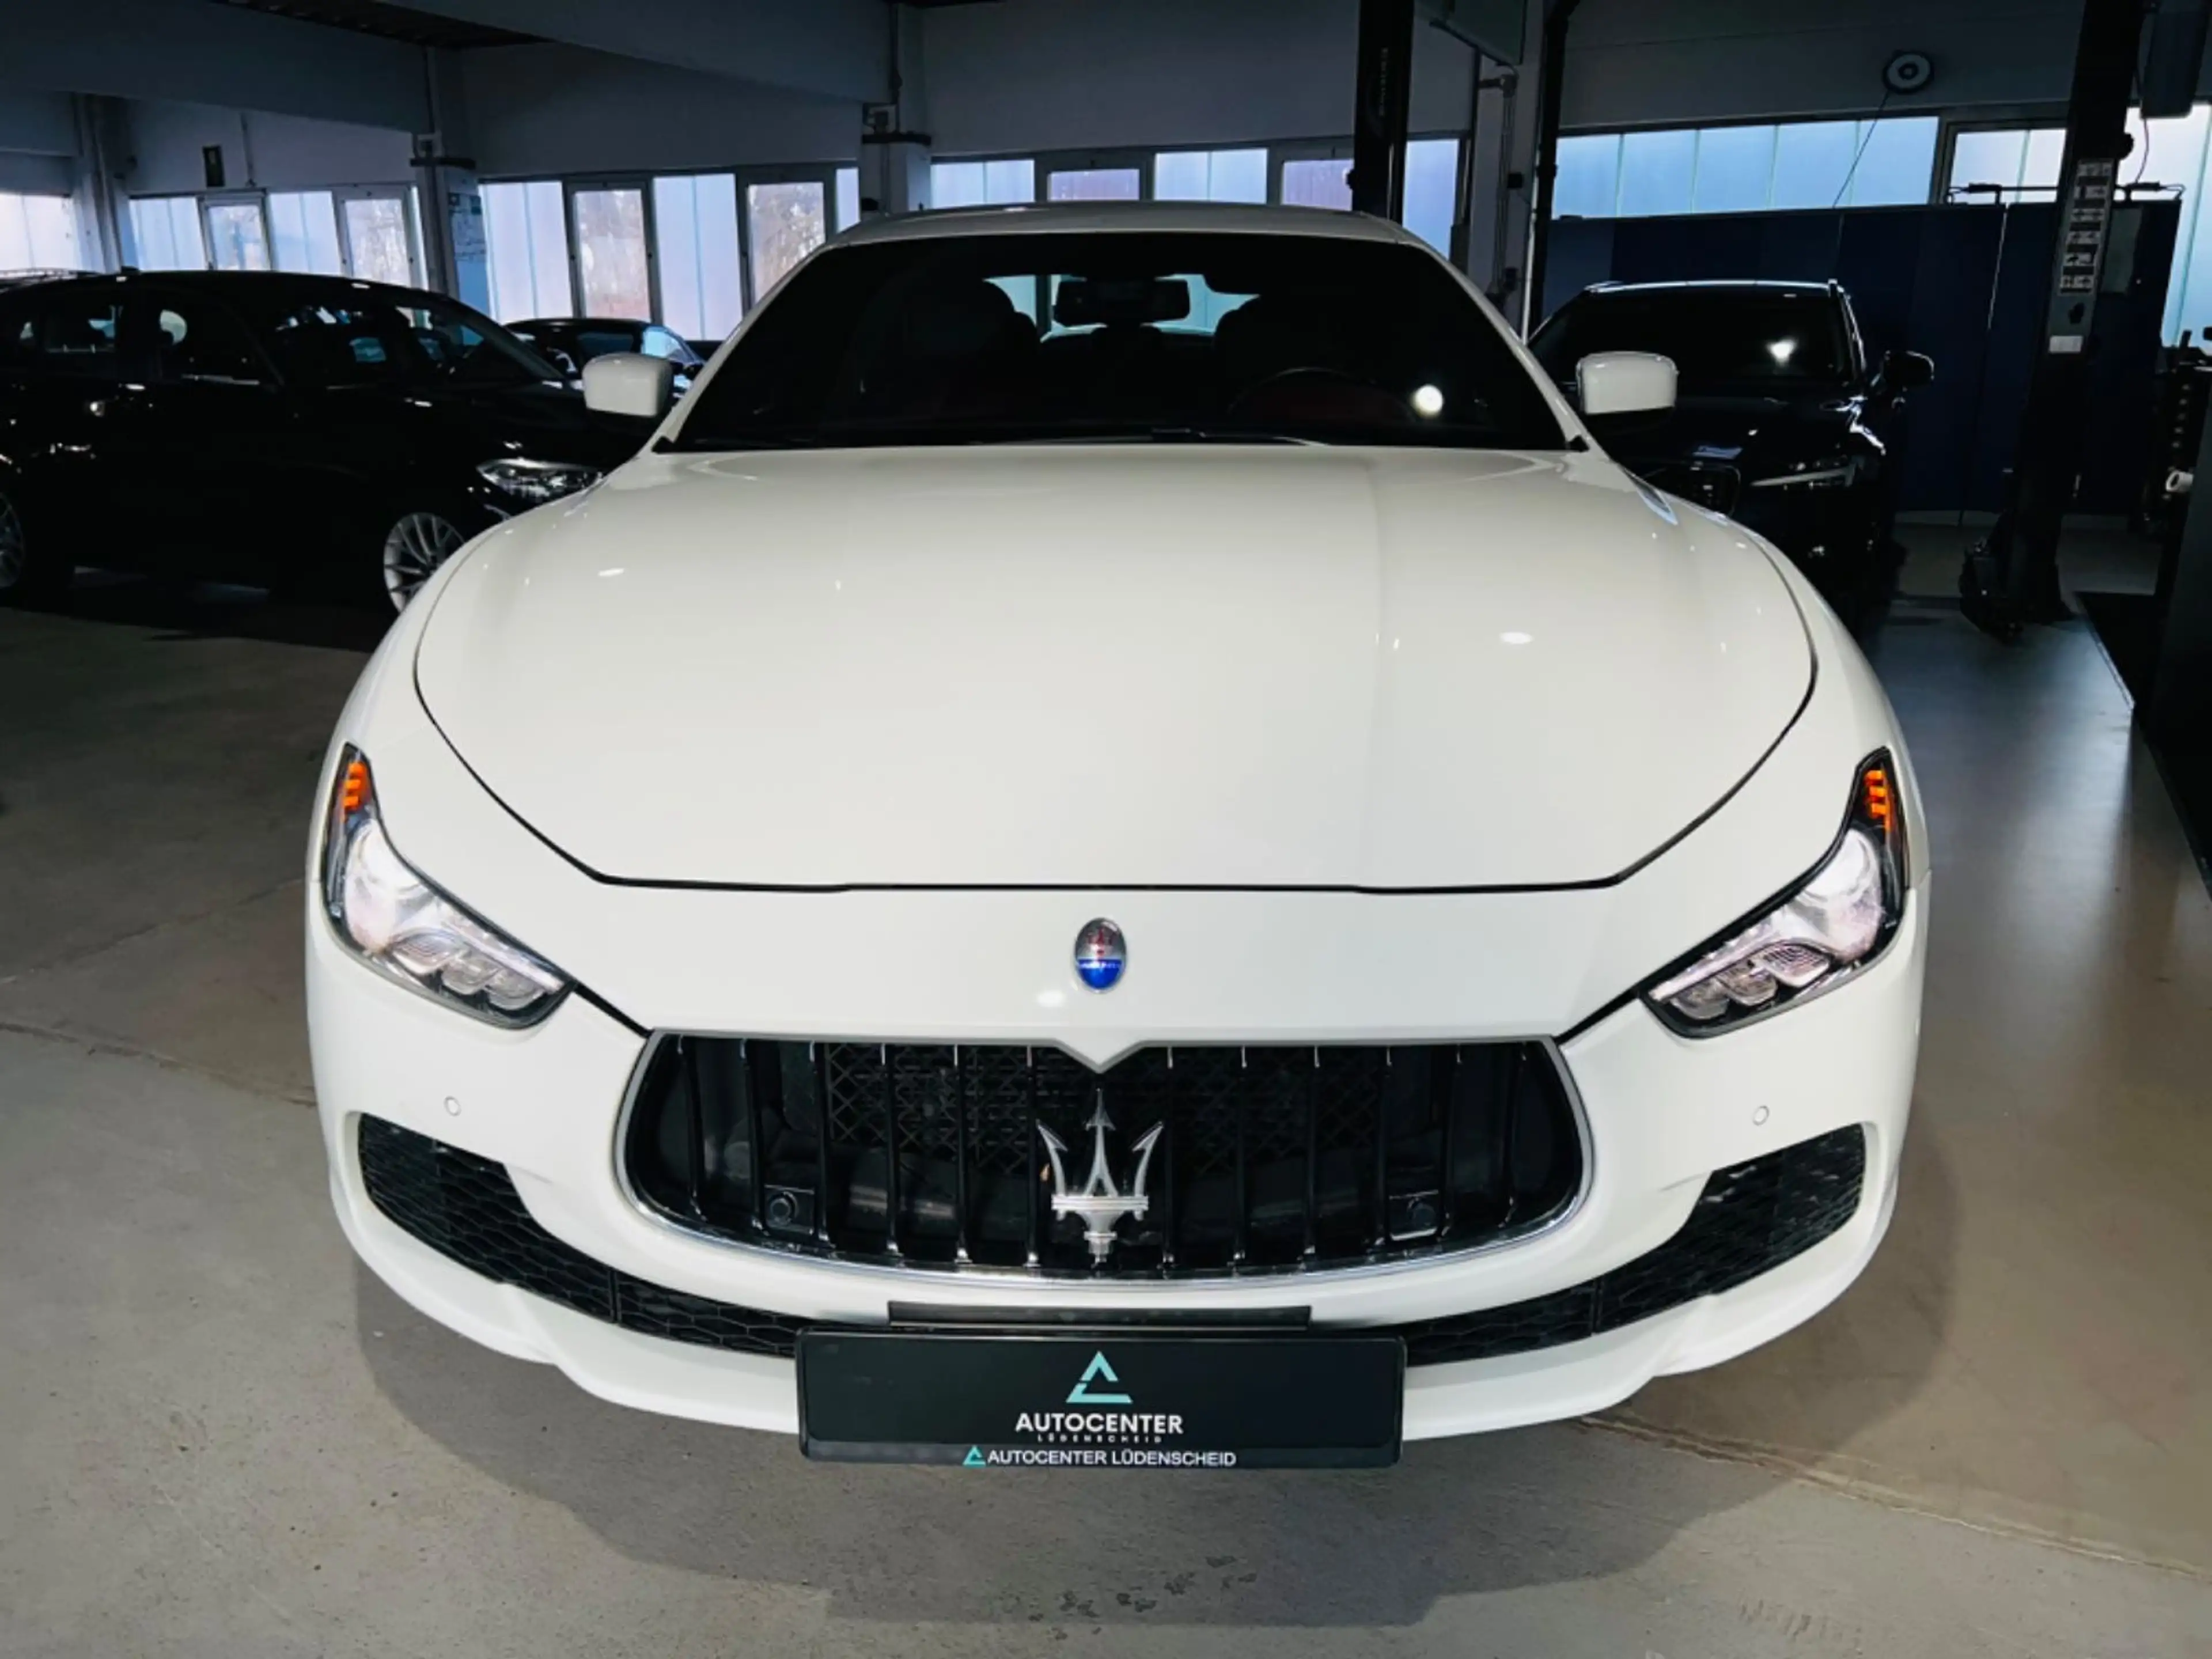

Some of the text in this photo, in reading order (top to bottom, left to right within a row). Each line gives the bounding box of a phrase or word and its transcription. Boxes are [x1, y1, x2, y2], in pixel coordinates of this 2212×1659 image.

[1015, 1412, 1184, 1434] AUTOCENTER
[987, 1448, 1237, 1467] AUTOCENTER LÜDENSCHEID
